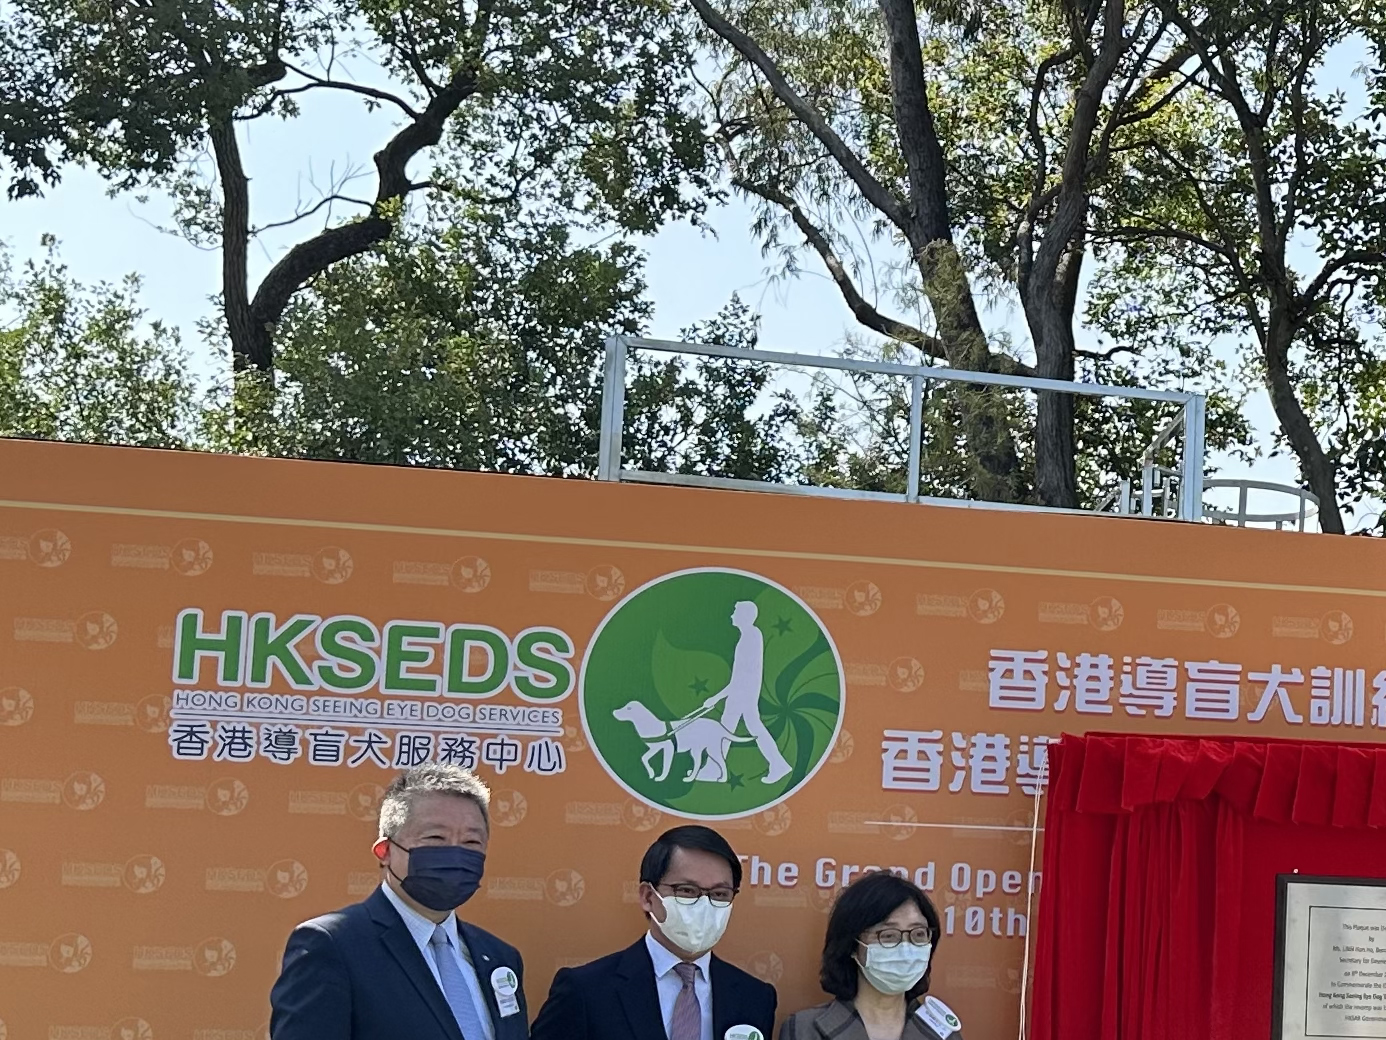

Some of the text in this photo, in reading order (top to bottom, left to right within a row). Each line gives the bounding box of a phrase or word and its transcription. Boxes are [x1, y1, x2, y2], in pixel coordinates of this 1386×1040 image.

[176, 611, 573, 700] HKSEDS
[176, 692, 560, 724] HONG KONG SEEING EYE DOG SERVICES
[172, 723, 562, 771] 香港導盲犬服務中心
[944, 905, 1027, 936] 10th
